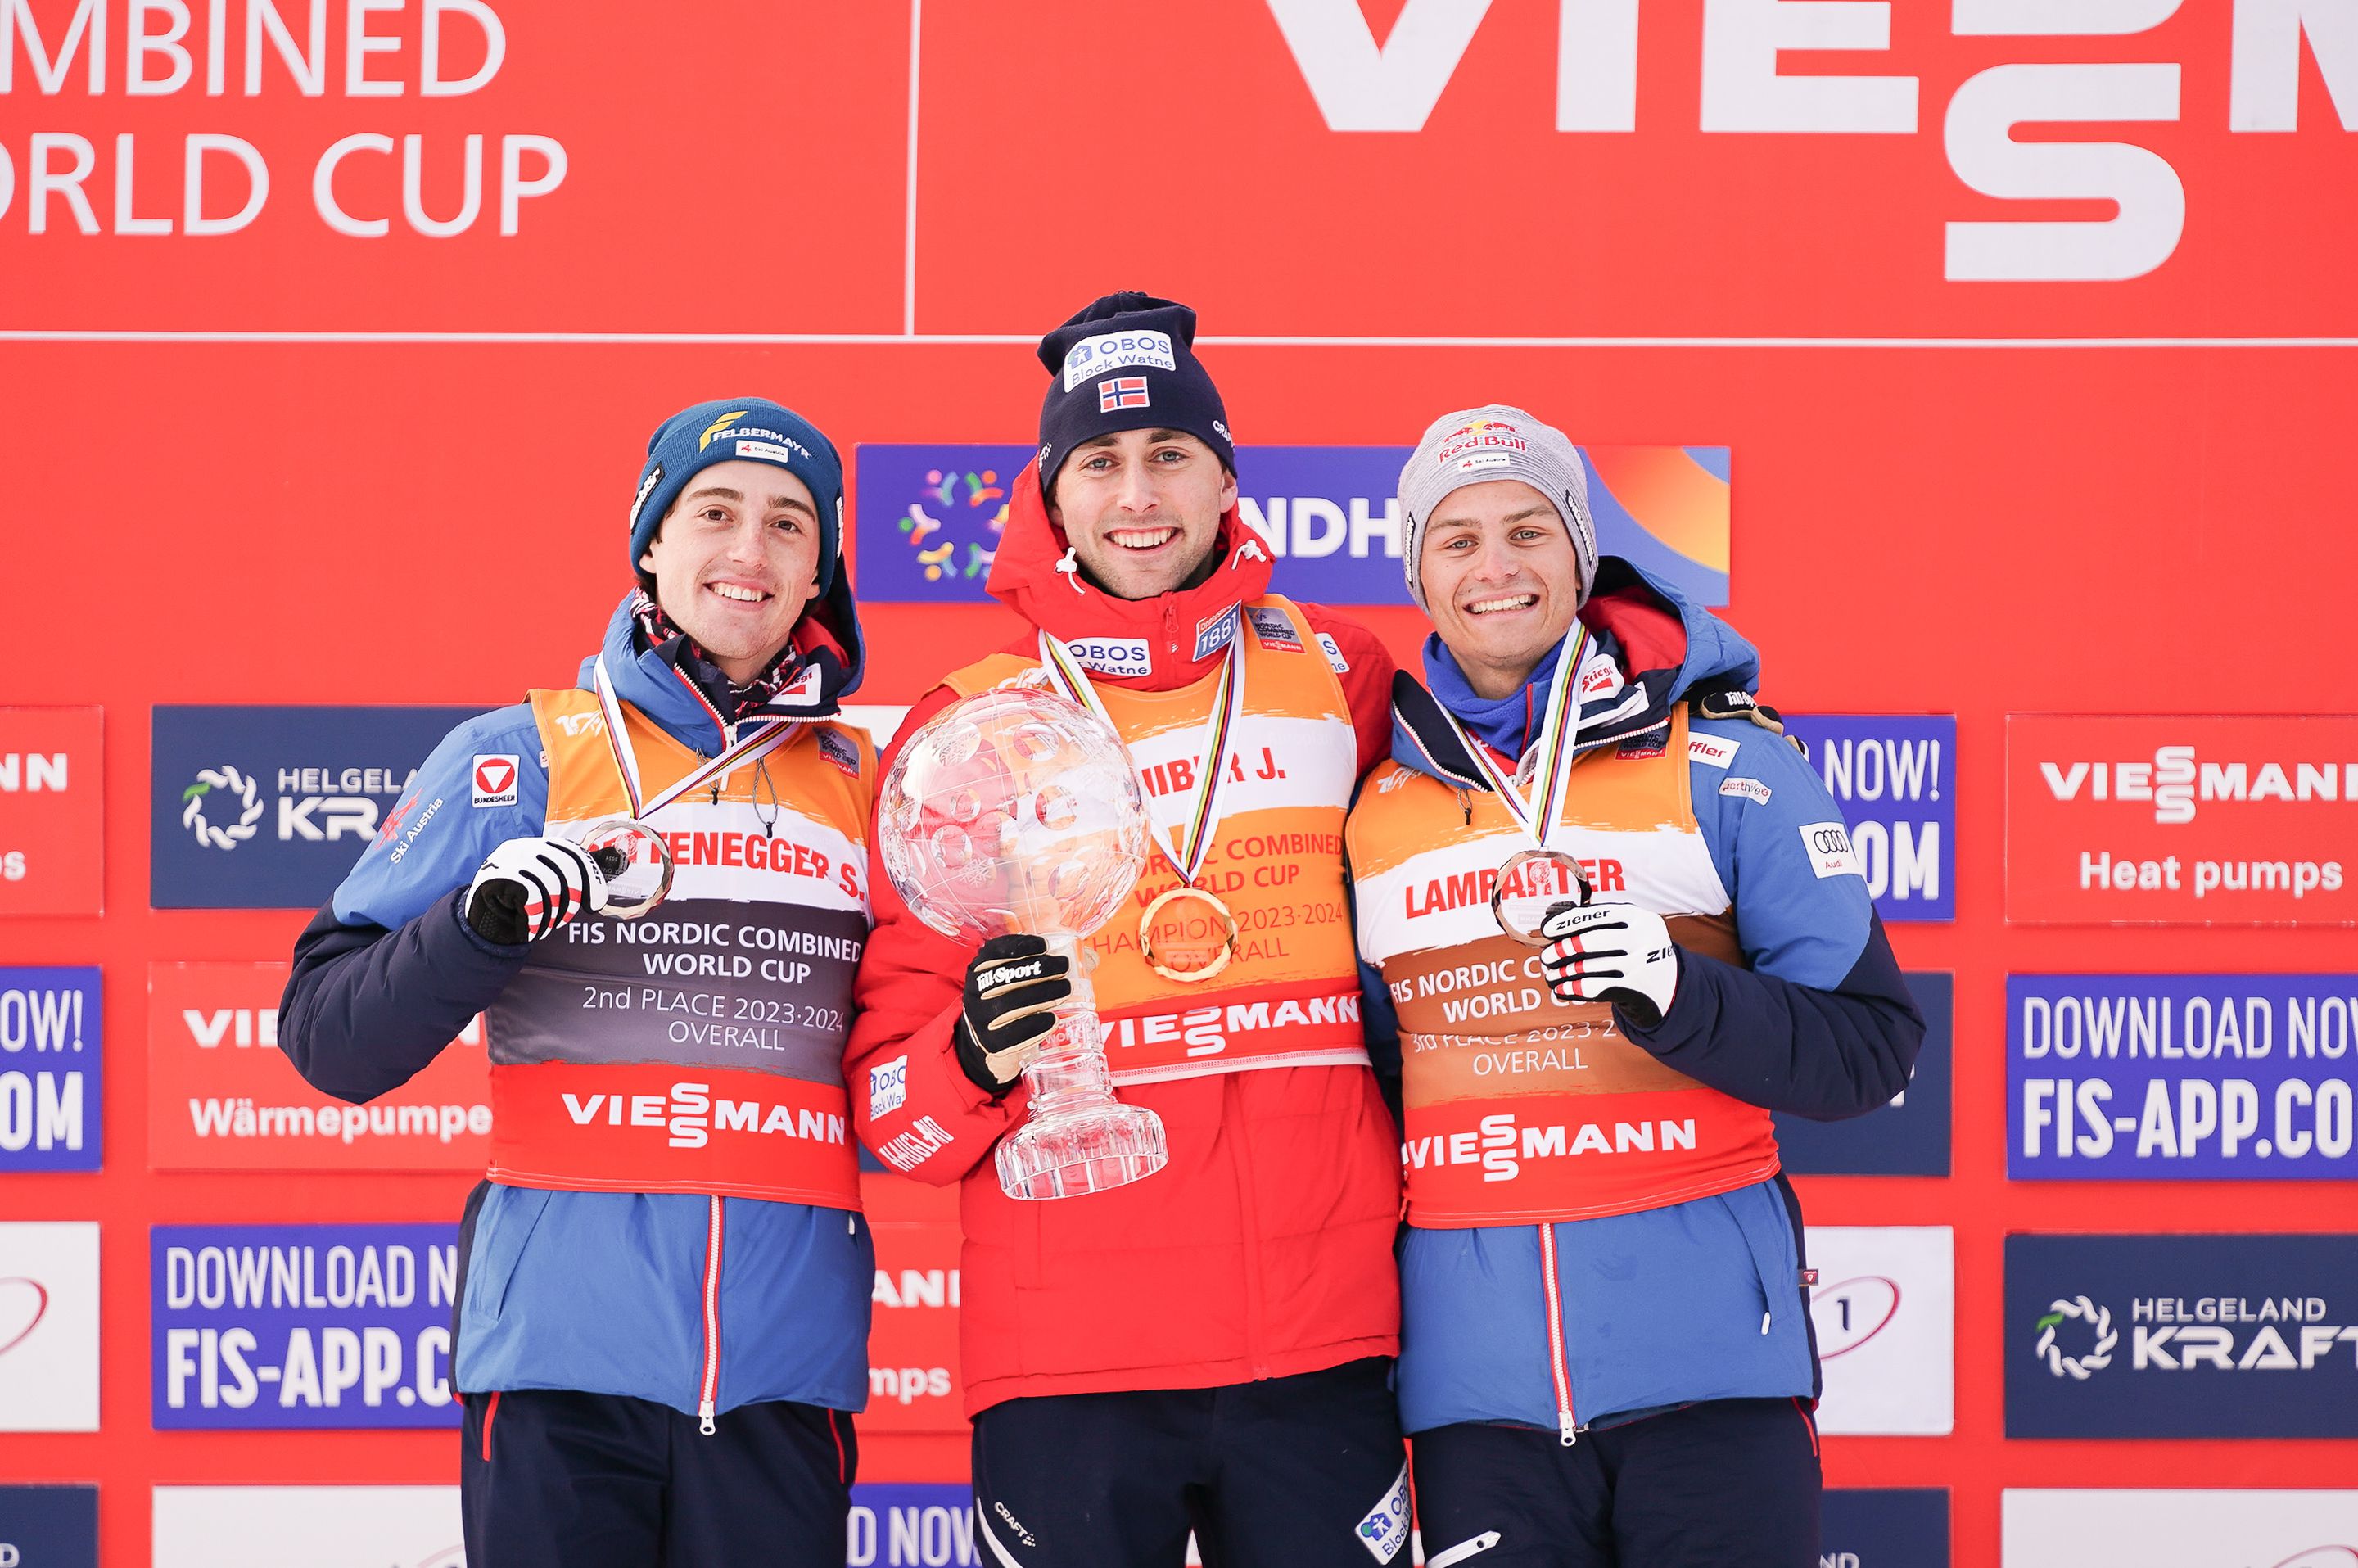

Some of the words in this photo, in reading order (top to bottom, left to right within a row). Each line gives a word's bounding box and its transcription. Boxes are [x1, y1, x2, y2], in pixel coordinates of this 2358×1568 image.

[0, 133, 270, 237] RLD
[312, 132, 568, 238] CUP
[1100, 337, 1170, 355] OBOS
[1071, 359, 1114, 385] Block
[1118, 353, 1173, 368] Watne
[712, 427, 811, 459] FELBERMAYR
[1438, 436, 1478, 463] Red
[1484, 436, 1527, 451] Bull
[1200, 611, 1237, 653] 1881
[1068, 644, 1146, 662] OBOS
[1086, 662, 1148, 675] Watne
[1255, 746, 1287, 781] J.
[1824, 739, 1940, 802] NOW!
[474, 794, 516, 804] BUNDESHEER
[390, 839, 409, 865] Ski
[405, 798, 445, 843] Austria
[1226, 833, 1343, 861] COMBINED
[1825, 860, 1843, 869] Audi
[2080, 851, 2180, 890] Heat
[2194, 859, 2344, 899] pumps
[838, 865, 865, 902] S.
[1135, 871, 1245, 909] WRLD
[1254, 864, 1300, 888] CUP
[568, 921, 606, 944] FIS
[616, 922, 730, 947] NORDIC
[737, 926, 862, 964] COMBINED
[643, 953, 752, 979] WORLD
[761, 958, 812, 985] CUP
[1418, 958, 1516, 998] NORDIC
[582, 986, 631, 1010] 2nd
[641, 988, 725, 1019] PLACE
[1443, 987, 1542, 1024] WORLD
[668, 1019, 785, 1051] OVERALL
[2023, 996, 2273, 1060] DOWNLOAD
[1472, 1047, 1588, 1076] OVERALL
[561, 1082, 845, 1149] VIESSMANN
[1401, 1114, 1696, 1182] VIESSMANN
[166, 1245, 416, 1309] DOWNLOAD
[2132, 1297, 2327, 1322] HELGELAND
[995, 1501, 1028, 1539] CRAFT
